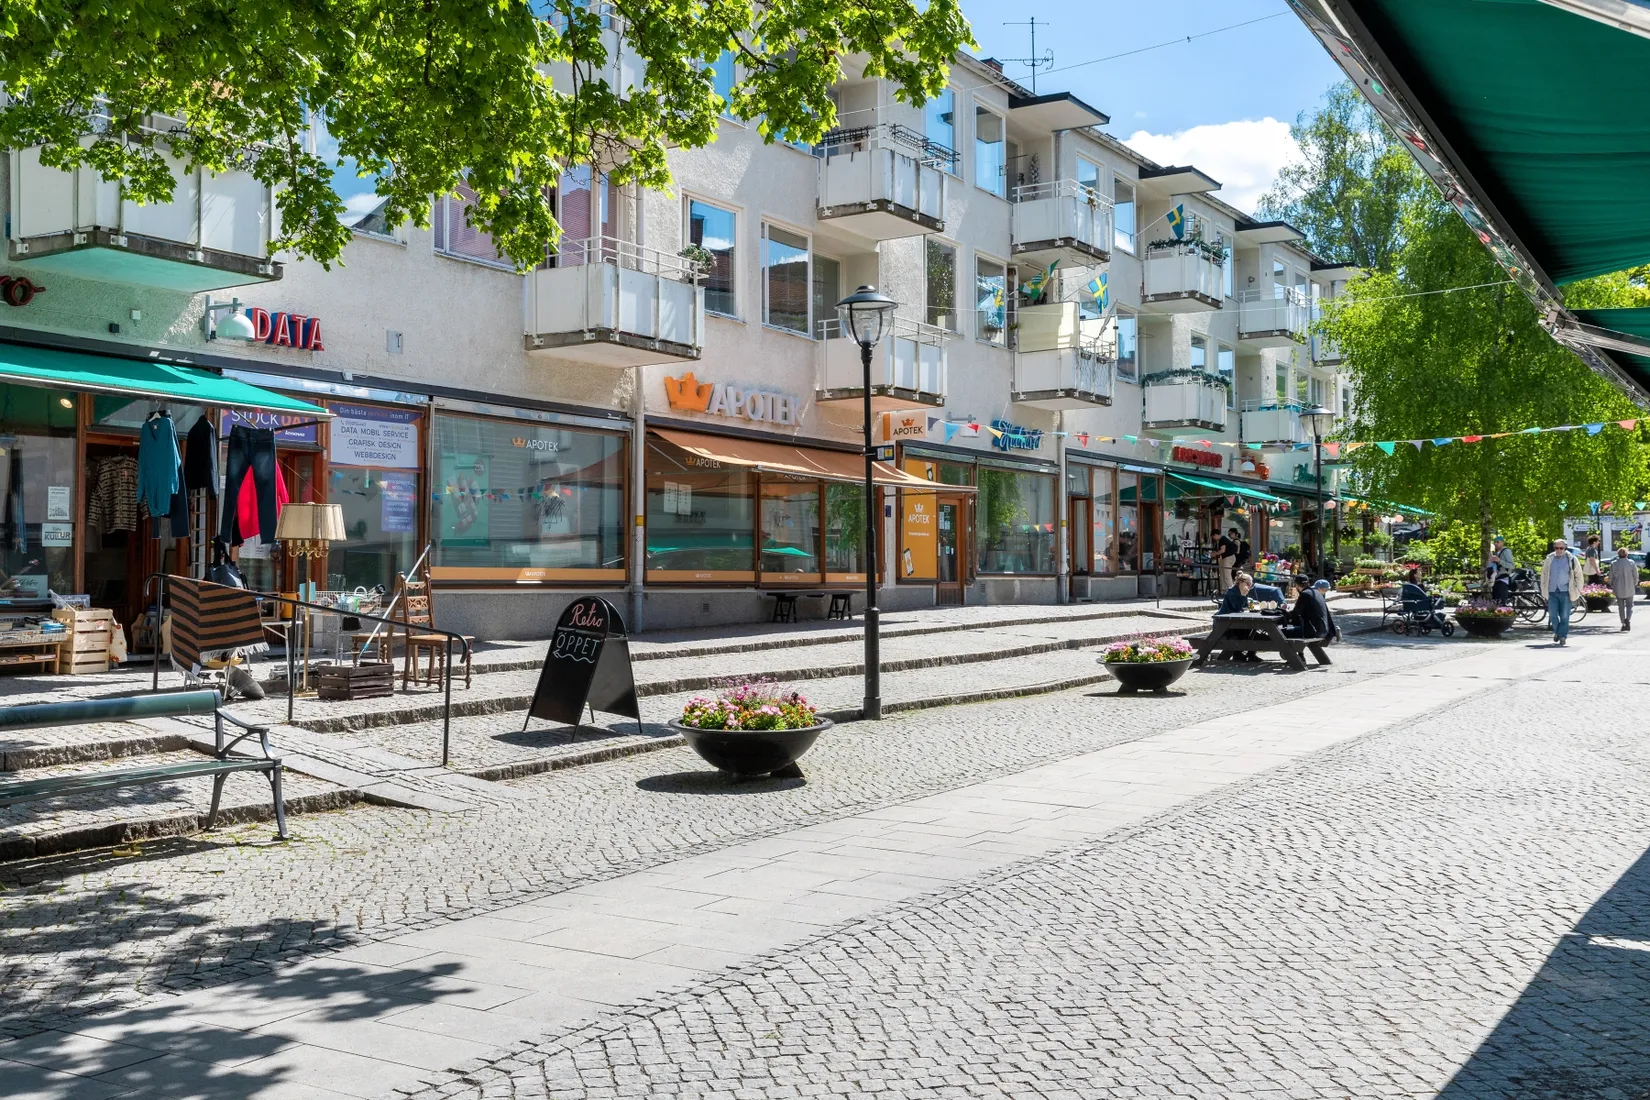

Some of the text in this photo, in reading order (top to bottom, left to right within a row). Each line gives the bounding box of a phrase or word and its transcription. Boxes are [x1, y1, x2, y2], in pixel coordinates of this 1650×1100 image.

[248, 307, 324, 351] DATA
[707, 383, 803, 426] APOTEK
[341, 426, 408, 438] DATA MOBIL SERVICE
[893, 426, 923, 435] APOTEK
[348, 438, 375, 447] GRAFISK
[378, 441, 401, 449] DESIGN
[526, 440, 558, 451] APOTEK
[354, 451, 396, 460] WEBBDESIGN
[695, 459, 721, 468] APOTEK
[908, 514, 930, 523] APOTEK
[45, 531, 71, 541] KULTUR
[569, 603, 603, 627] Retro
[556, 632, 600, 656] ÖPPET
